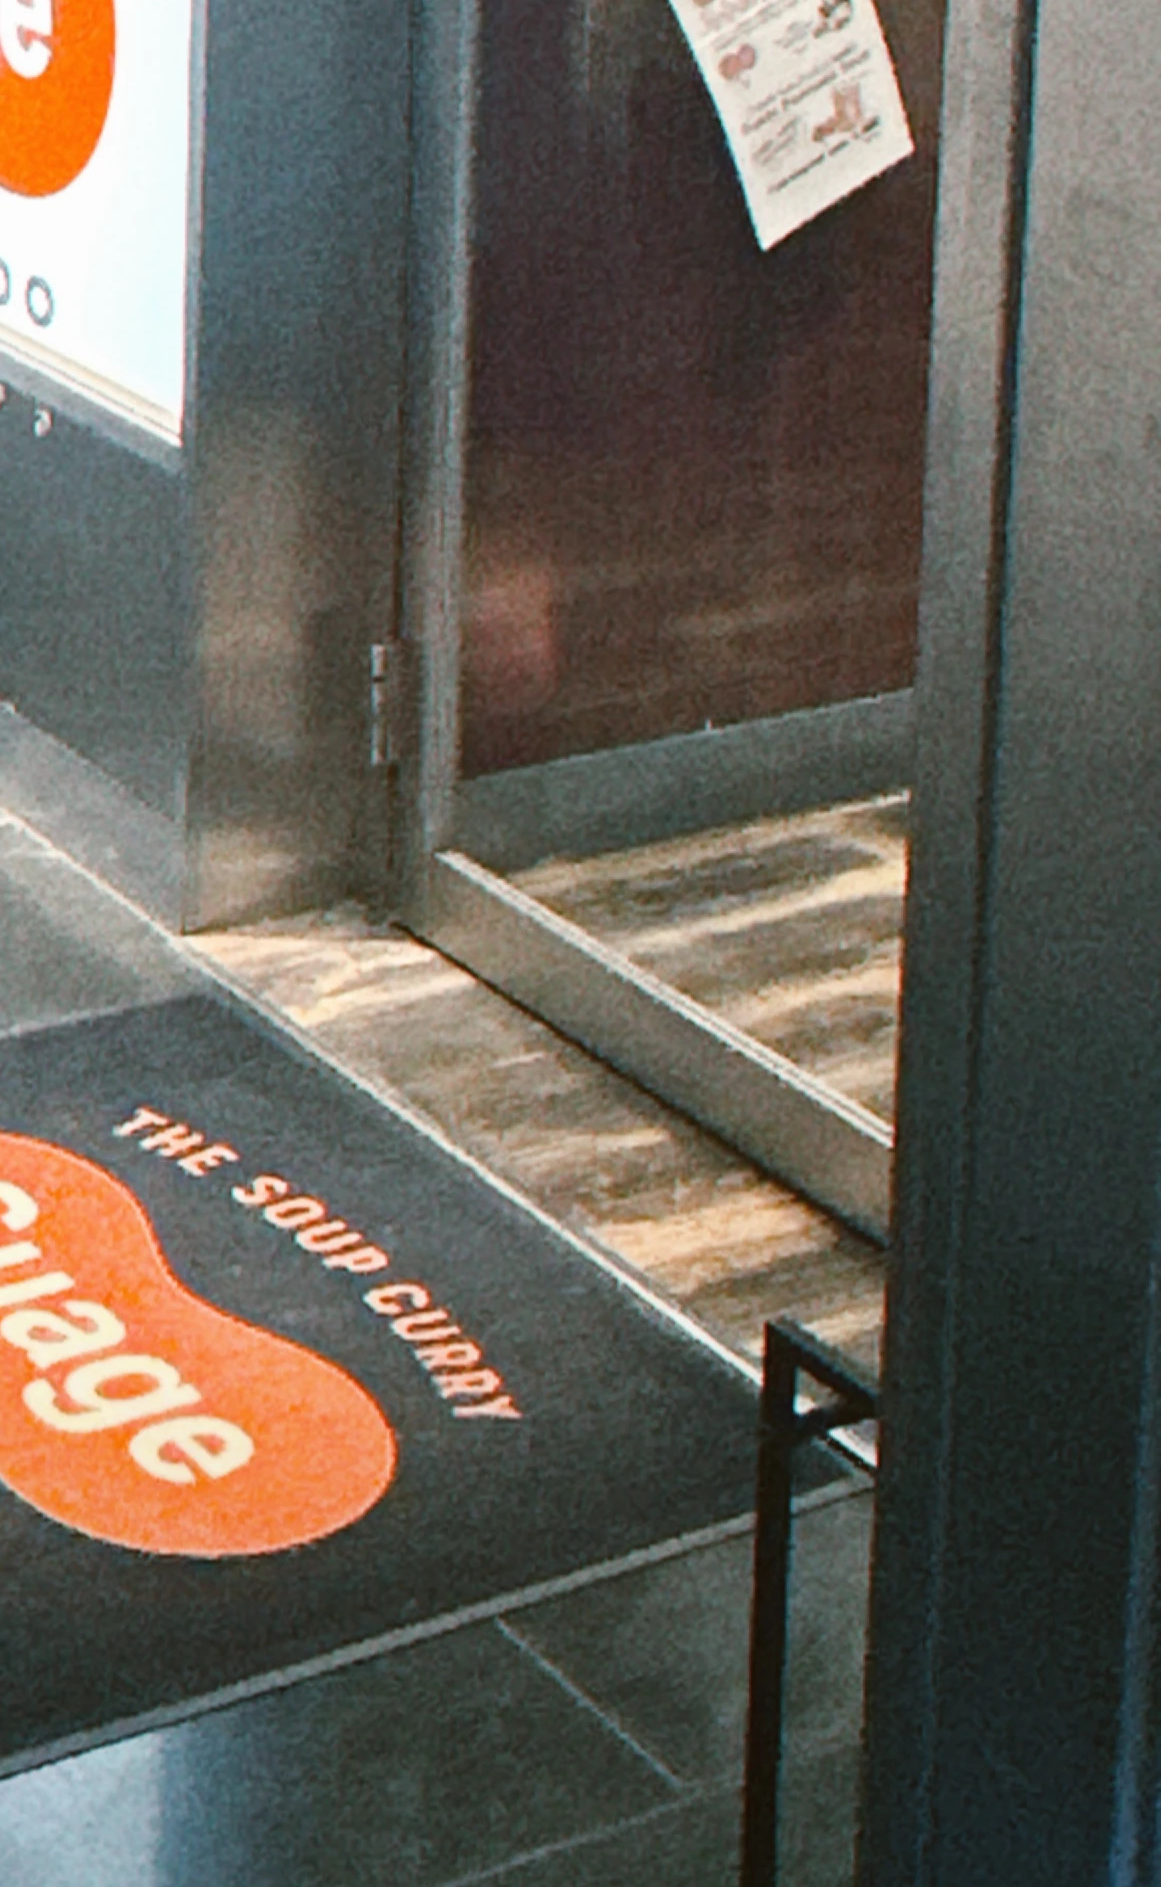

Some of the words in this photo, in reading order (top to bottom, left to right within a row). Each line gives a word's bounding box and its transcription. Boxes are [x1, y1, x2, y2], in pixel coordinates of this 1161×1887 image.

[111, 1105, 237, 1177] THE
[232, 1175, 388, 1275] SOUP
[361, 1280, 523, 1420] CURRY
